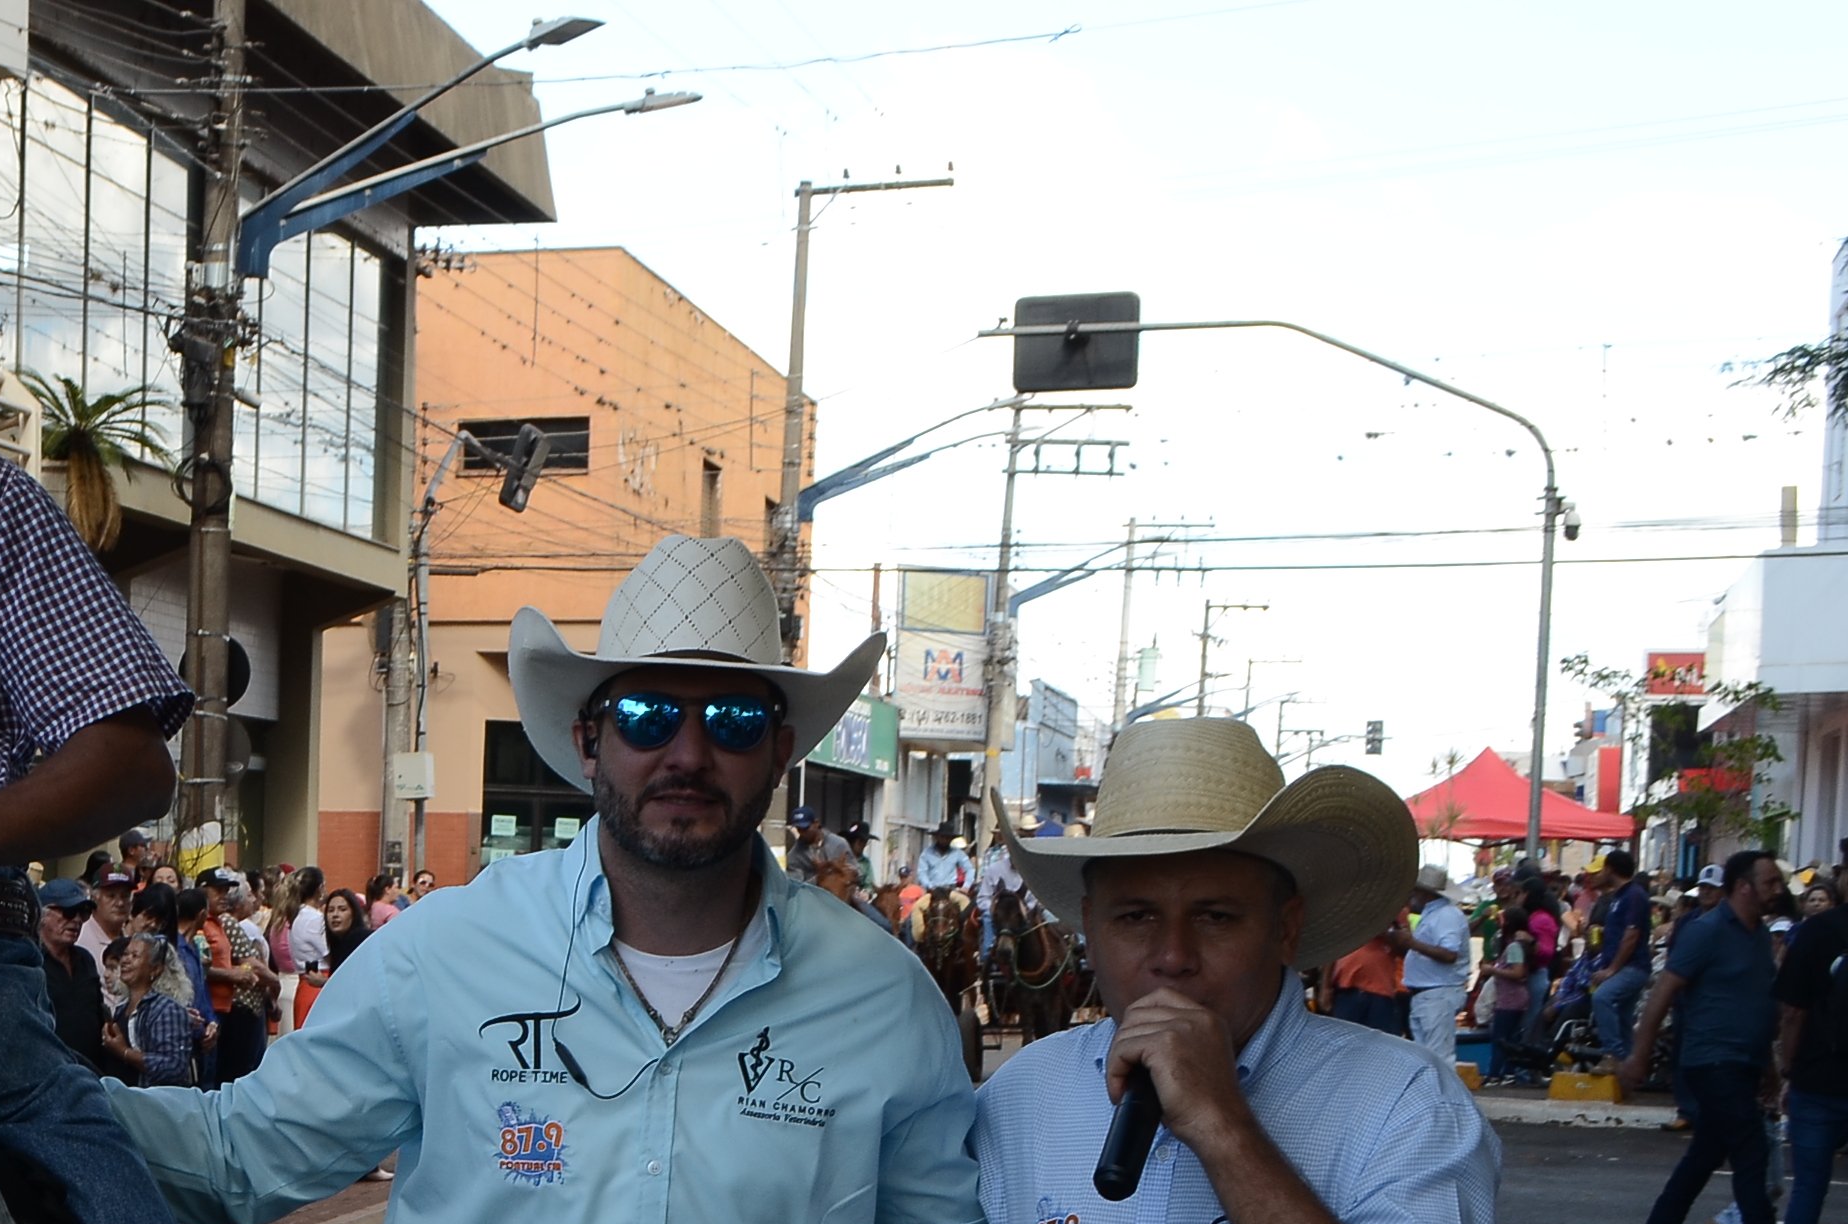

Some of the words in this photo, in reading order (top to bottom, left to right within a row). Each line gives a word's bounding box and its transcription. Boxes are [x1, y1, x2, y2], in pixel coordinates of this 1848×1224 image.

[491, 1069, 527, 1083] ROPE
[531, 1070, 568, 1084] TIME
[737, 1096, 767, 1109] RIAN
[773, 1101, 837, 1118] CHAMORRO
[740, 1107, 781, 1122] Assessoria
[500, 1121, 564, 1156] 87.9
